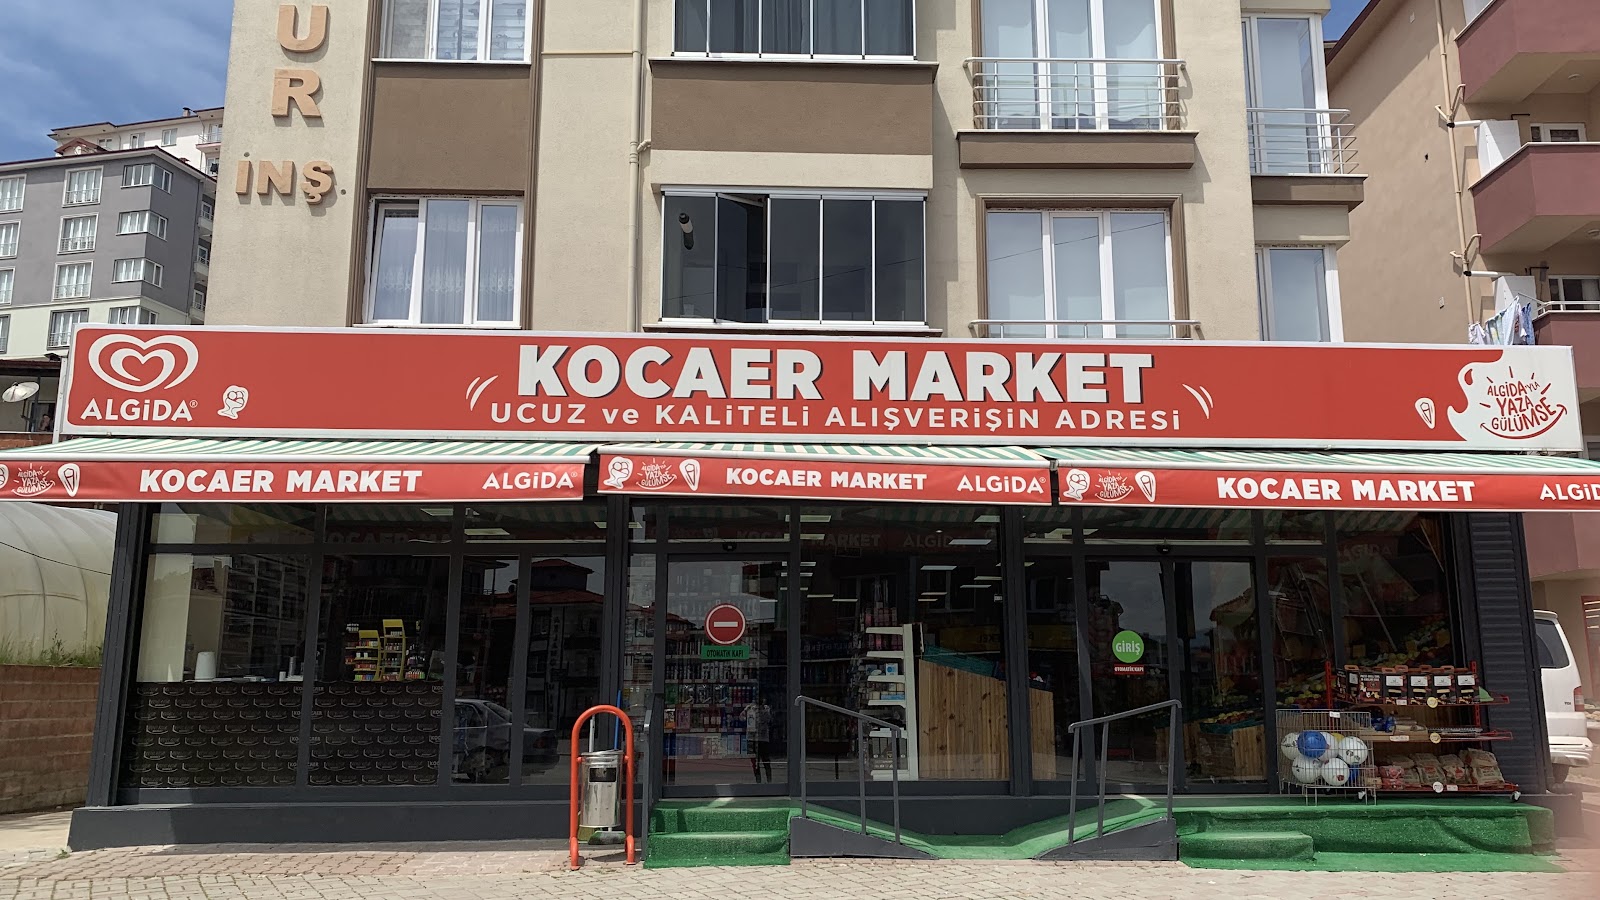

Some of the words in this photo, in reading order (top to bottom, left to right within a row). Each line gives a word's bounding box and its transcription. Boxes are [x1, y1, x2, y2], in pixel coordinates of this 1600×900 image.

[517, 344, 823, 401] KOCAER
[852, 350, 1154, 405] MARKET
[491, 402, 586, 424] UCUZ
[601, 408, 639, 425] ve
[1491, 396, 1557, 432] GÜLÜMSE
[1496, 395, 1534, 416] YAZA
[139, 469, 275, 493] KOCAER
[285, 470, 423, 493] MARKET
[726, 467, 822, 488] KOCAER
[830, 470, 928, 490] MARKET
[1216, 476, 1343, 501] KOCAER
[1350, 479, 1476, 502] MARKET
